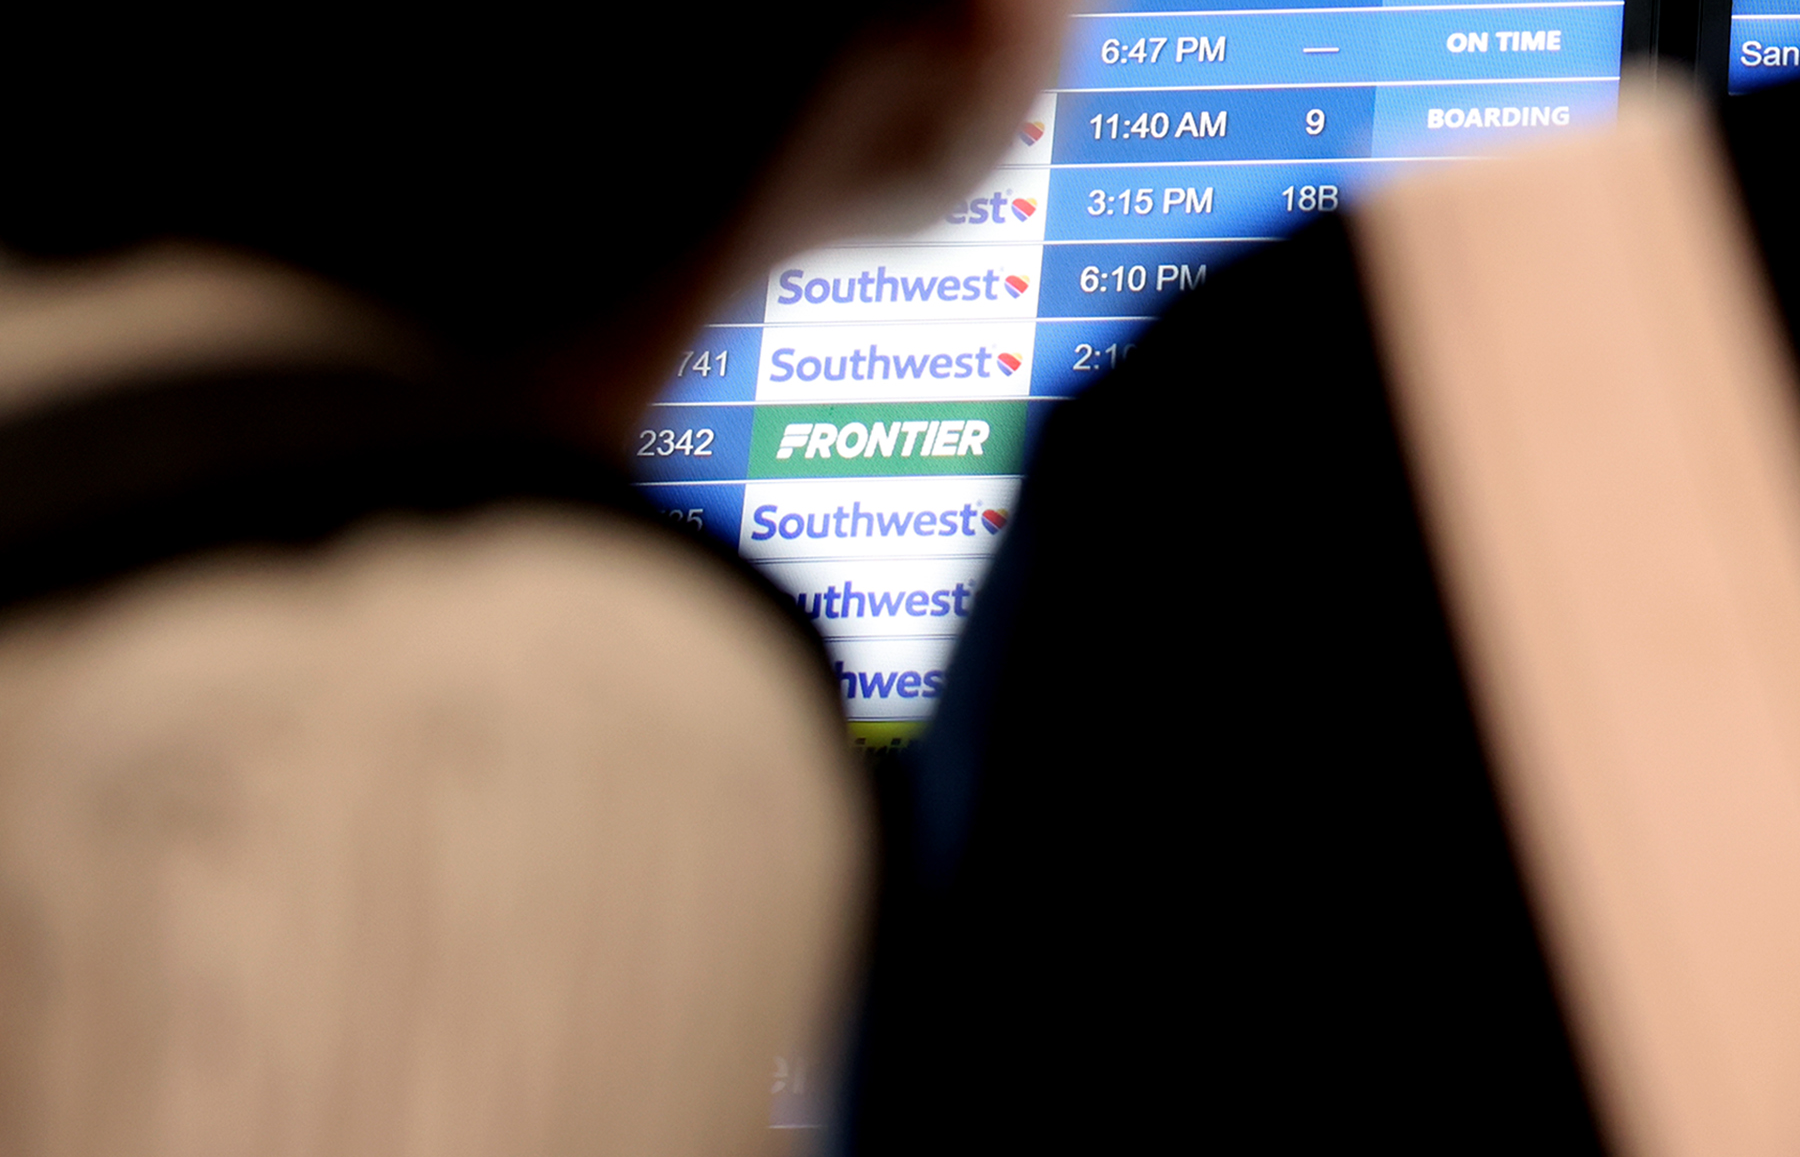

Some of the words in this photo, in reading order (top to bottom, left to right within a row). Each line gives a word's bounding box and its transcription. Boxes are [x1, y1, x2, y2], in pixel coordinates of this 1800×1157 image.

[1101, 39, 1167, 64] 6:47
[1176, 36, 1226, 62] PM
[1740, 41, 1799, 66] San
[1089, 113, 1170, 139] 11:40
[1175, 111, 1228, 137] AM
[1305, 109, 1325, 134] 9
[1427, 107, 1570, 129] BOARDING
[1087, 189, 1154, 216] 3:15
[1162, 187, 1213, 214] PM
[1282, 185, 1339, 212] 18B
[777, 265, 999, 305] Southwest
[1080, 265, 1147, 293] 6:10
[769, 345, 991, 384] Southwest
[638, 429, 714, 458] 2342
[776, 420, 990, 459] FRONTIER
[751, 501, 977, 541] Southwest
